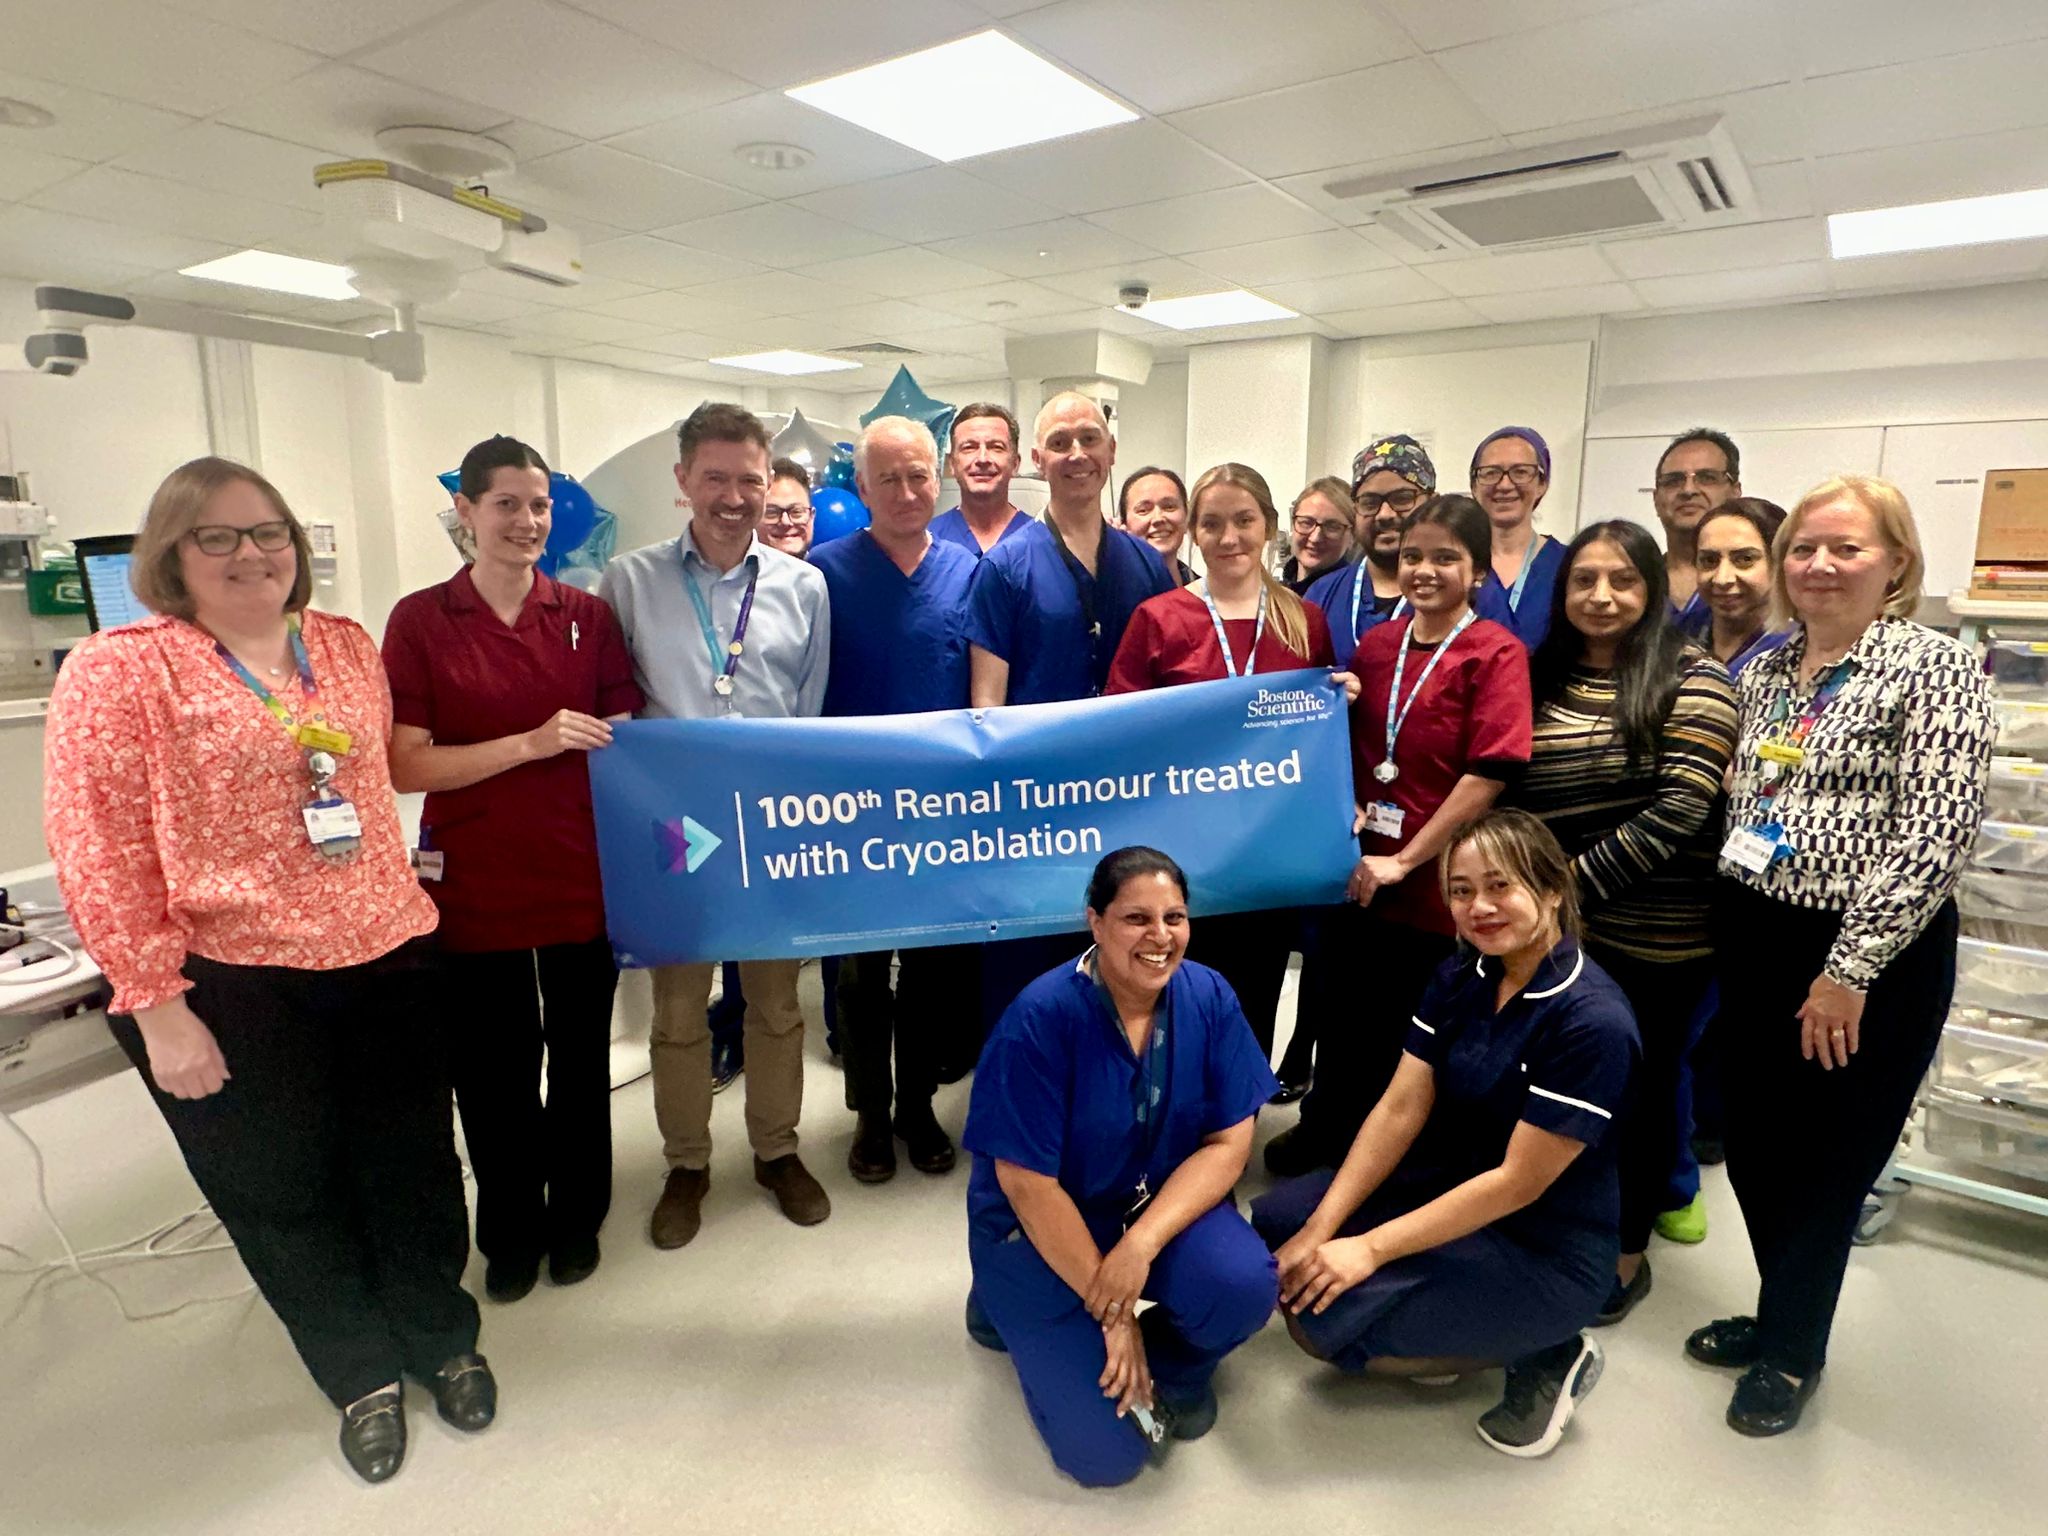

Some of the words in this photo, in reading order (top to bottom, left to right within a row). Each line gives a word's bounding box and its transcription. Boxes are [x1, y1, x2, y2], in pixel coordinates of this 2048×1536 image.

[1247, 693, 1326, 718] Scientific
[1257, 688, 1306, 705] Boston
[757, 788, 882, 829] 1000th
[894, 781, 1001, 820] Renal
[1011, 770, 1156, 810] Tumour
[1165, 749, 1302, 796] treated
[763, 840, 850, 880] with
[861, 823, 1102, 876] Cryoablation
